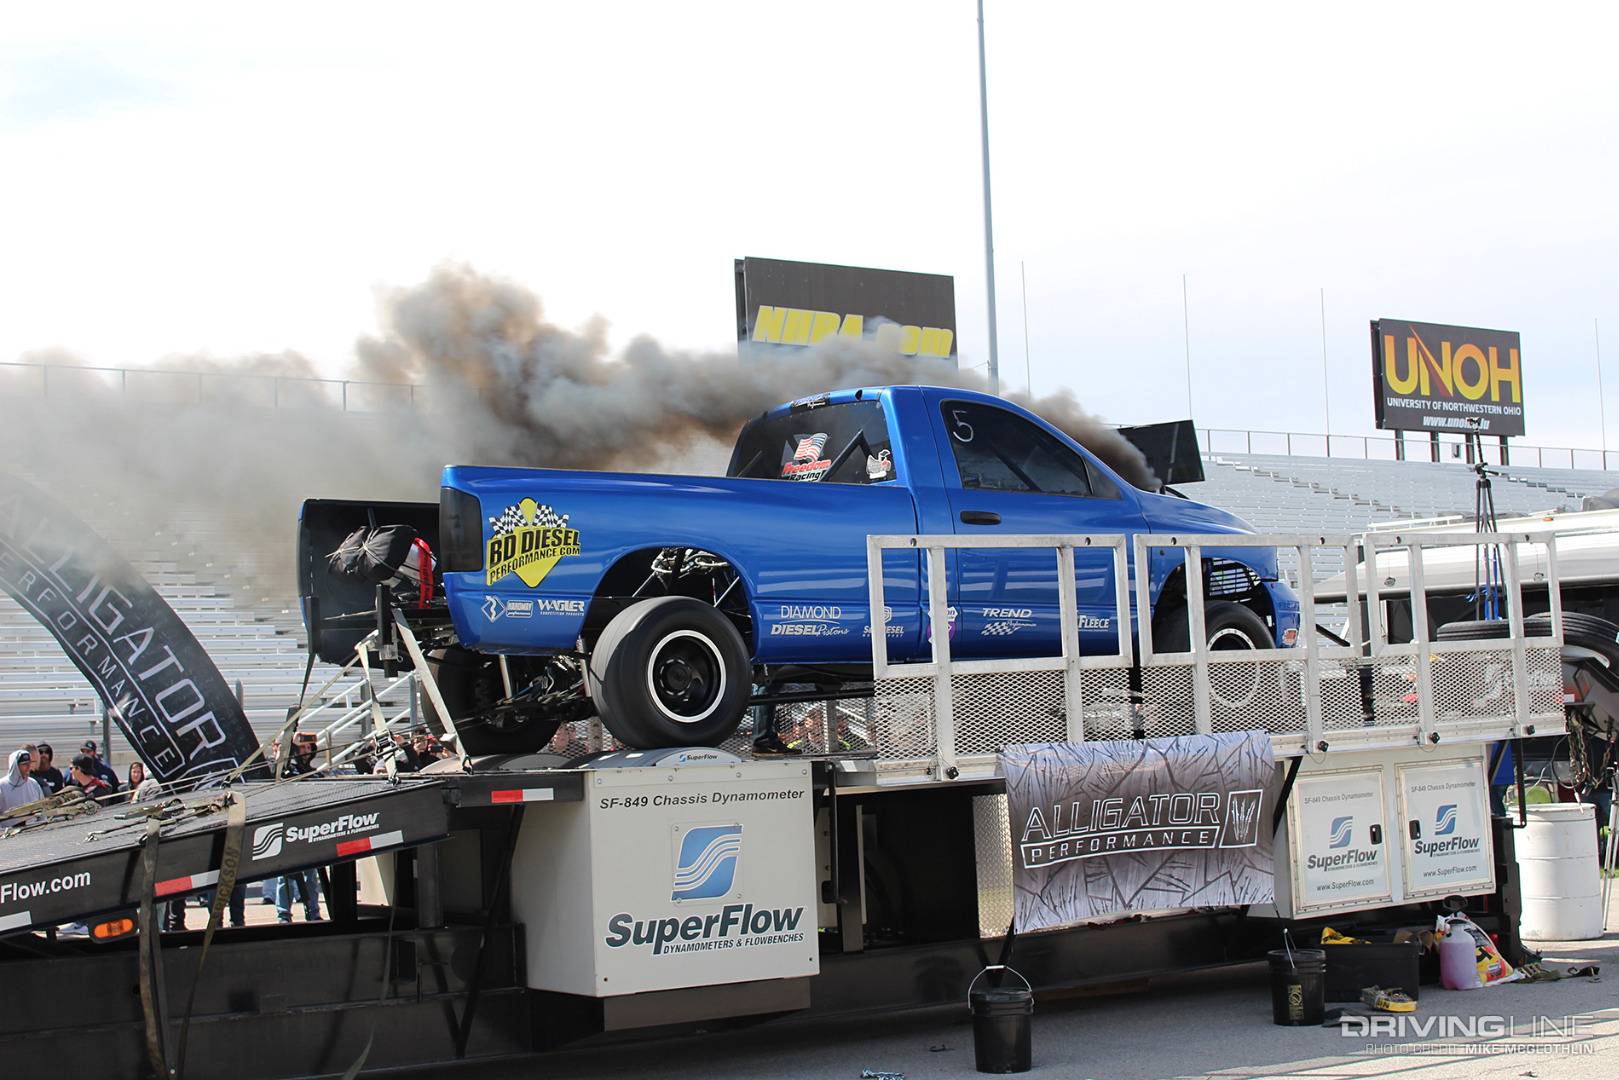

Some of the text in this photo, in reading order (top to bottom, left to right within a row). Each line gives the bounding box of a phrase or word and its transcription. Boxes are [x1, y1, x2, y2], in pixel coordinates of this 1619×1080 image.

[1384, 324, 1521, 403] UNOH
[1387, 397, 1522, 416] UNIVERSITY OF NORTHWESTERN OHIO
[952, 410, 975, 443] 5
[782, 459, 832, 476] Freedom
[489, 528, 581, 570] BD DIESEL
[537, 599, 585, 612] WAGLER
[780, 605, 842, 620] DIAMOND
[982, 607, 1033, 618] TREND
[770, 624, 821, 636] DIESEL
[816, 623, 849, 637] Pistons
[686, 753, 718, 762] SuperFlow
[1445, 780, 1476, 789] Dynamometer
[600, 789, 805, 809] SF-849 Chassis Dynamometer
[1341, 791, 1374, 800] Dynamometer
[1021, 792, 1221, 841] ALLIGATOR
[285, 812, 379, 843] SuperFlow
[1031, 830, 1209, 862] PERFORMANCE
[1413, 836, 1480, 858] SuperFlow
[1307, 848, 1377, 872] SuperFlow
[1423, 865, 1477, 877] www.SuperFlow.com
[0, 872, 91, 904] Flow.com
[1316, 878, 1374, 891] www.SuperFlow.com
[605, 903, 804, 955] SuperFlow
[663, 938, 734, 954] DYNAMOMETERS
[744, 932, 804, 947] FLOWBENCHES
